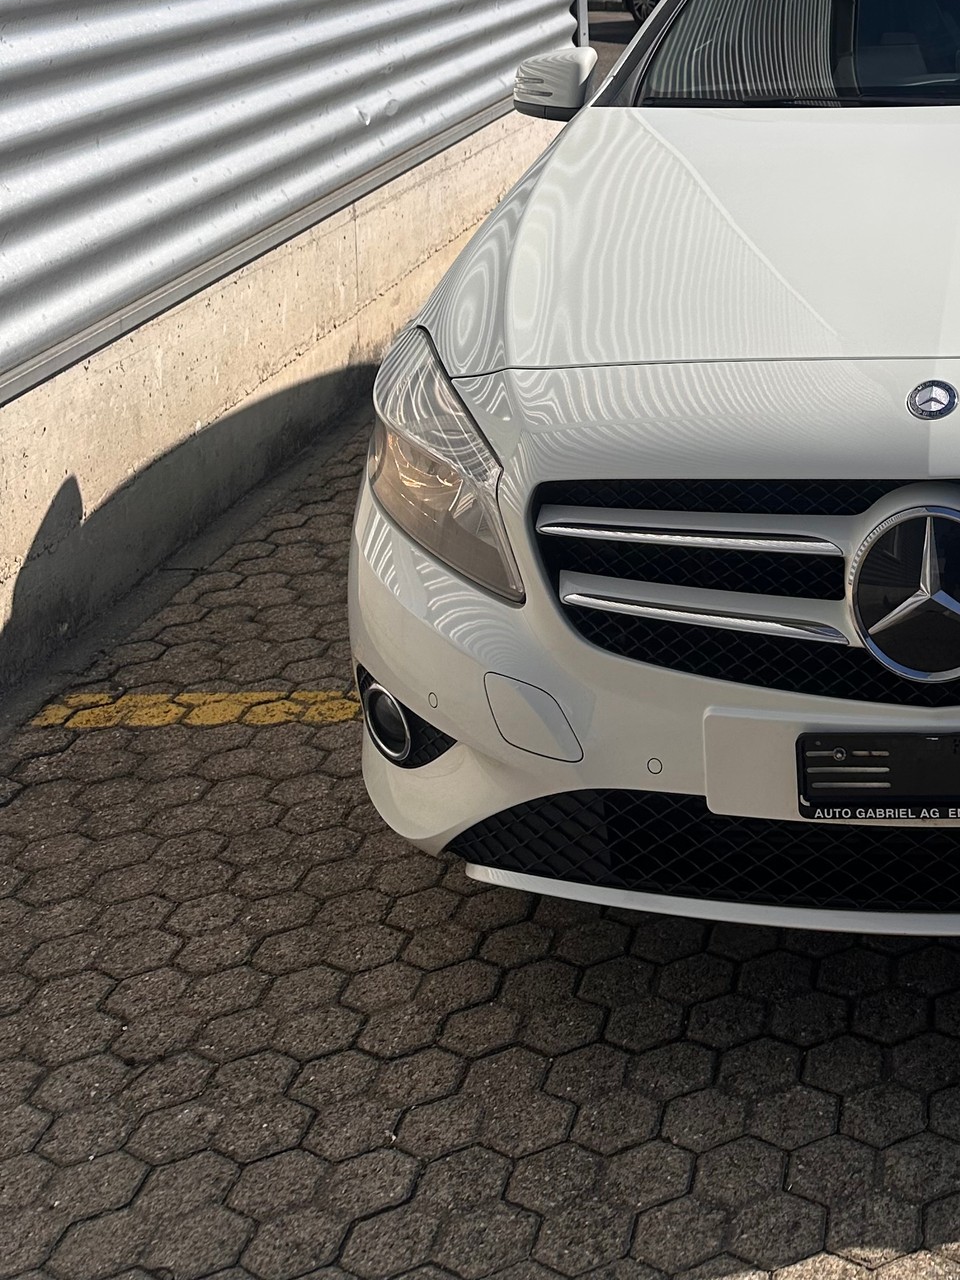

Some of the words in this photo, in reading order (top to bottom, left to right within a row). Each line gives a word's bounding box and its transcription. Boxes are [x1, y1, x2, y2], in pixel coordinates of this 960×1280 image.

[814, 808, 851, 818] AUTO
[856, 808, 916, 818] GABRIEL
[920, 808, 939, 818] AG
